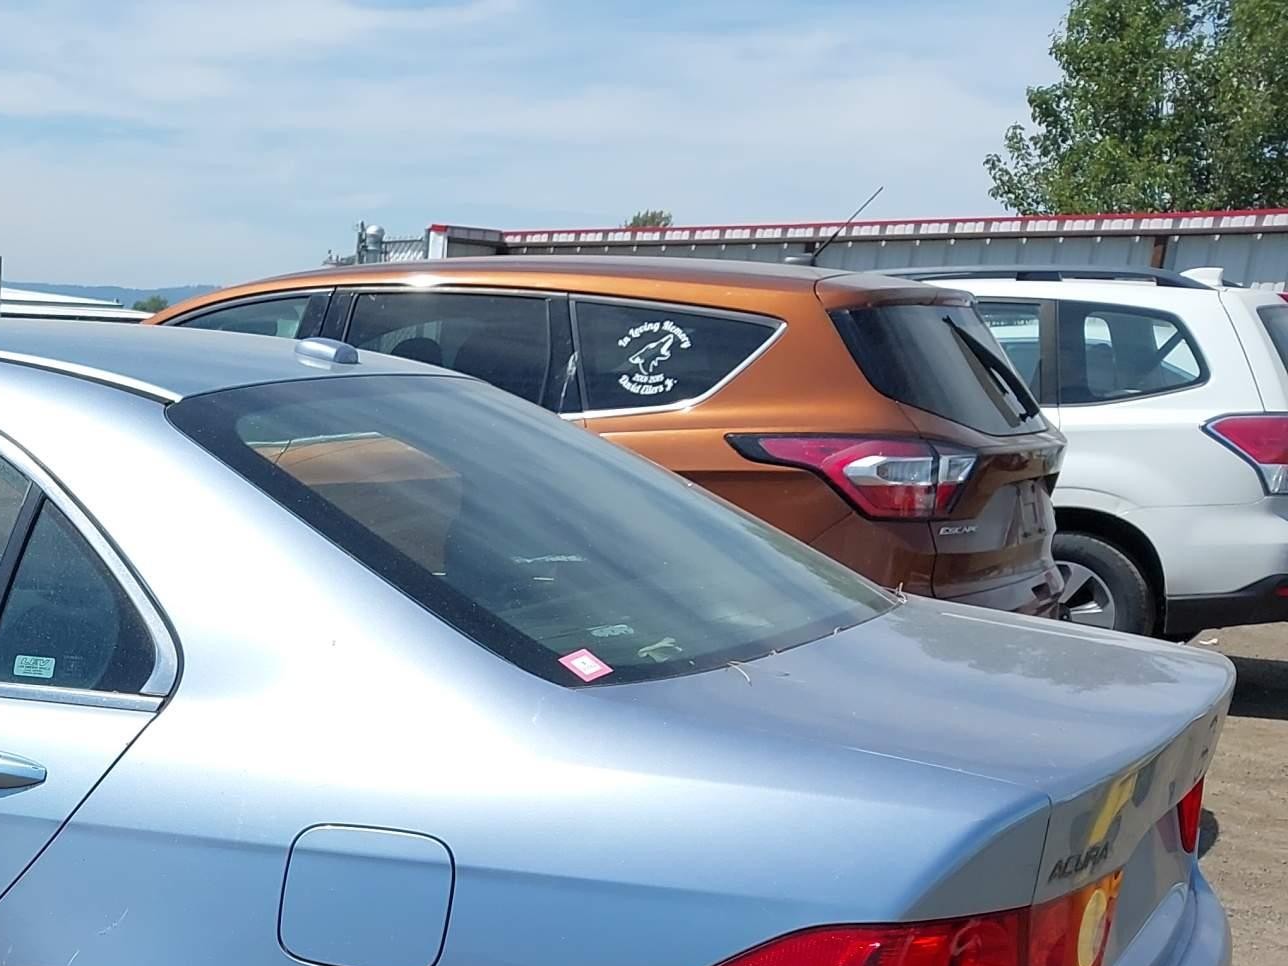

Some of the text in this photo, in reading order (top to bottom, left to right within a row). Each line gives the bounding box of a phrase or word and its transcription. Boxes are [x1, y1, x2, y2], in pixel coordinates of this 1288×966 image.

[629, 322, 660, 338] Loving
[661, 320, 692, 348] Memory
[1048, 841, 1109, 882] ACURA
